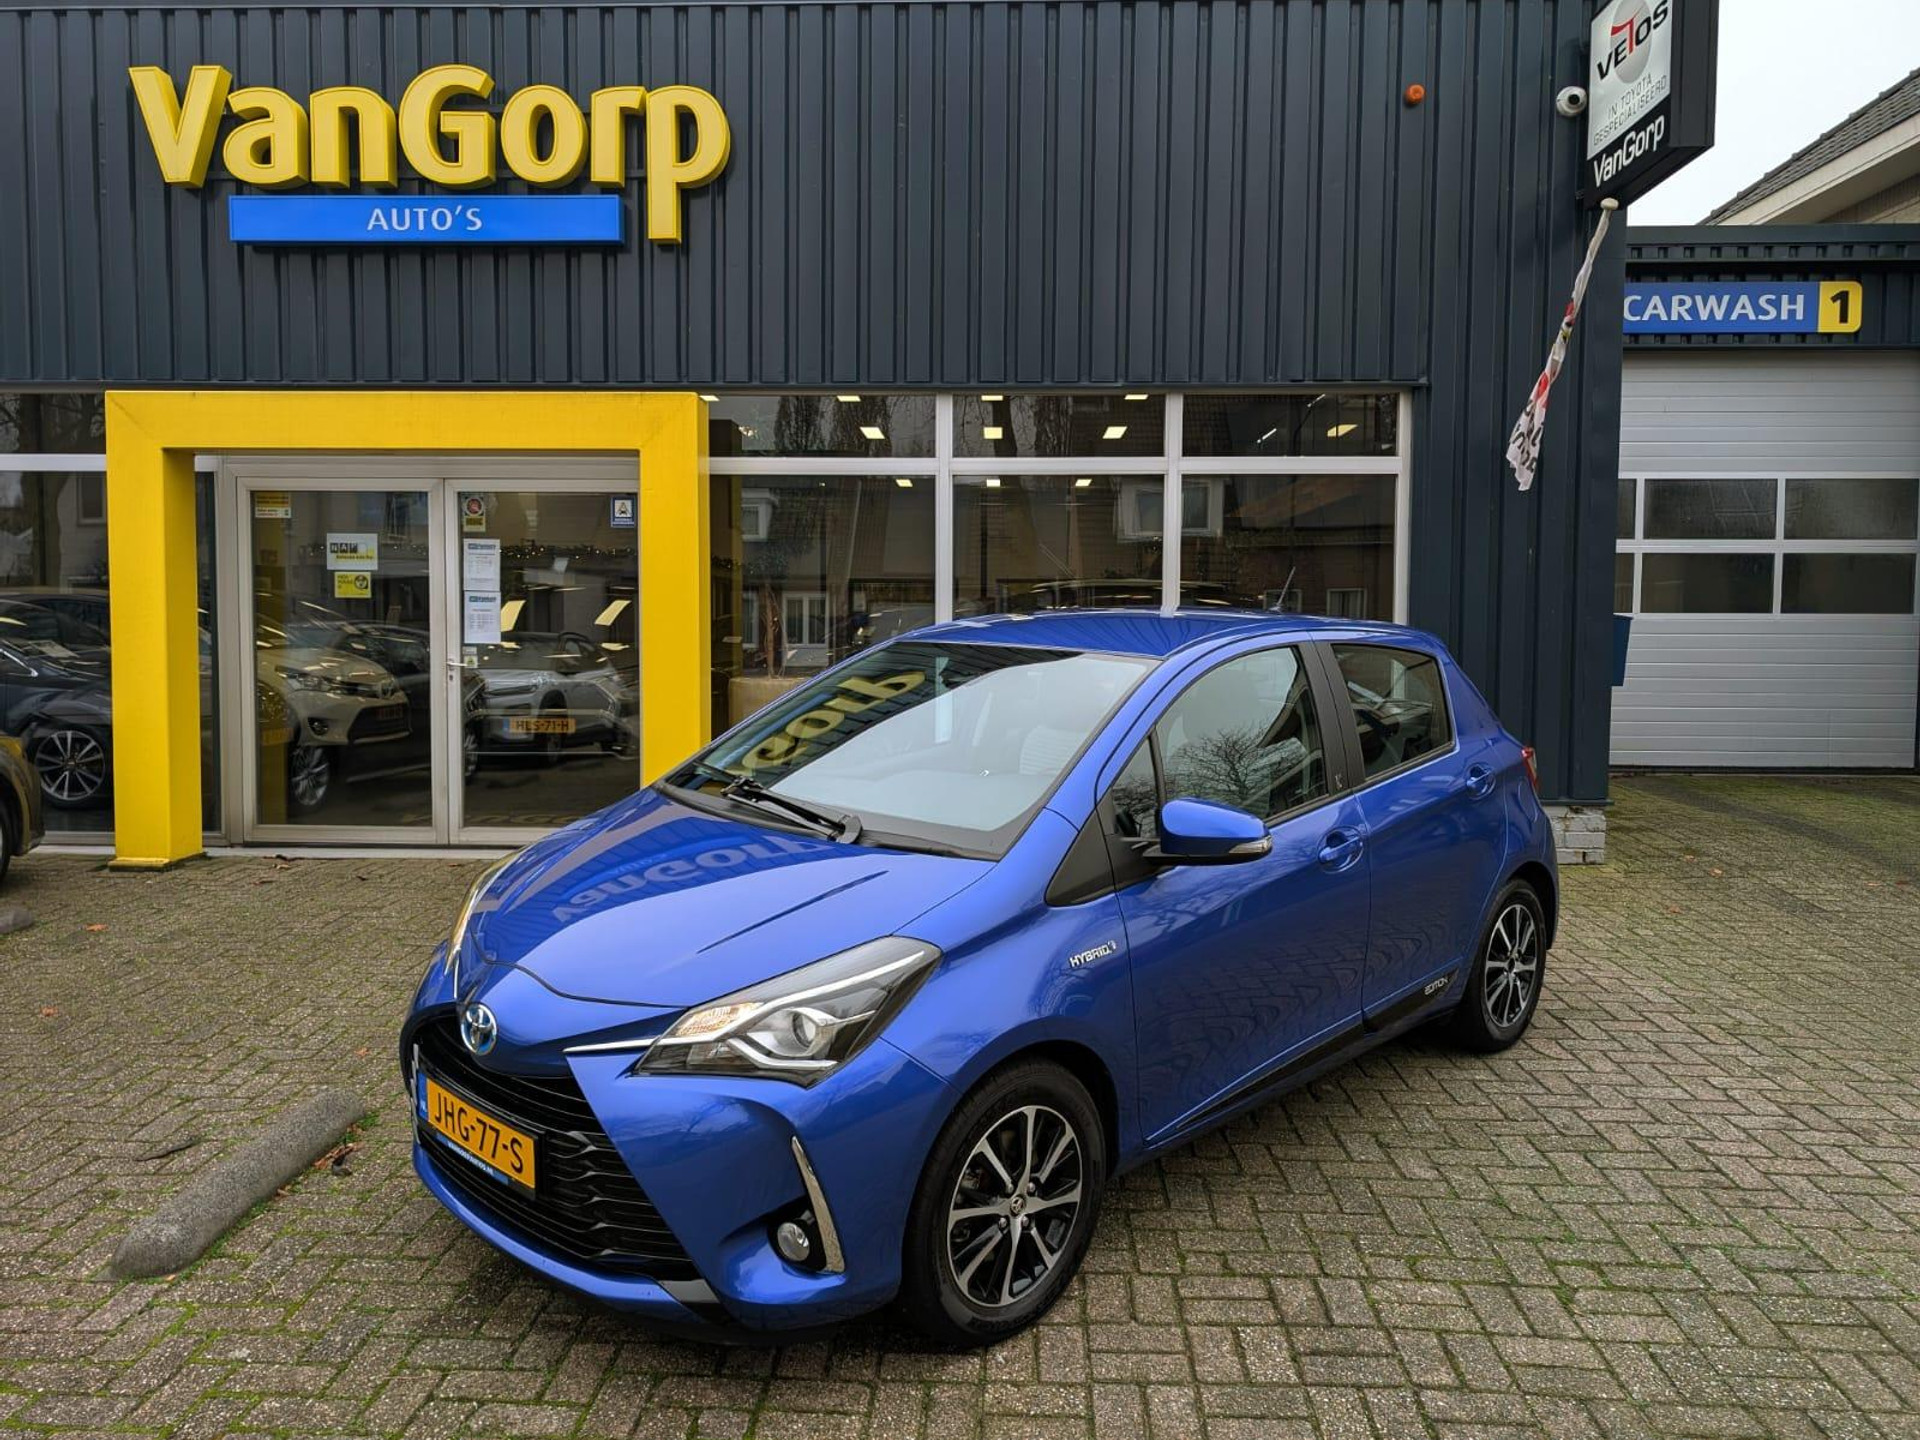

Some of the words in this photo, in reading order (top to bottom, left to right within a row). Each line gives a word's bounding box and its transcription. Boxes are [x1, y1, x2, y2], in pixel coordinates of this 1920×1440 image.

[1597, 0, 1668, 80] VETOS
[1593, 75, 1667, 146] GESPECIALISEERD
[1608, 103, 1618, 118] IN
[1621, 73, 1652, 107] TOYOTA
[128, 64, 731, 244] VanGorp
[1594, 115, 1665, 188] VanGorp
[366, 204, 483, 232] AUTO'S
[1624, 294, 1804, 321] CARWASH
[1830, 290, 1849, 324] 1
[1069, 944, 1112, 968] HYBRID
[434, 1092, 524, 1175] JHG-77-S
